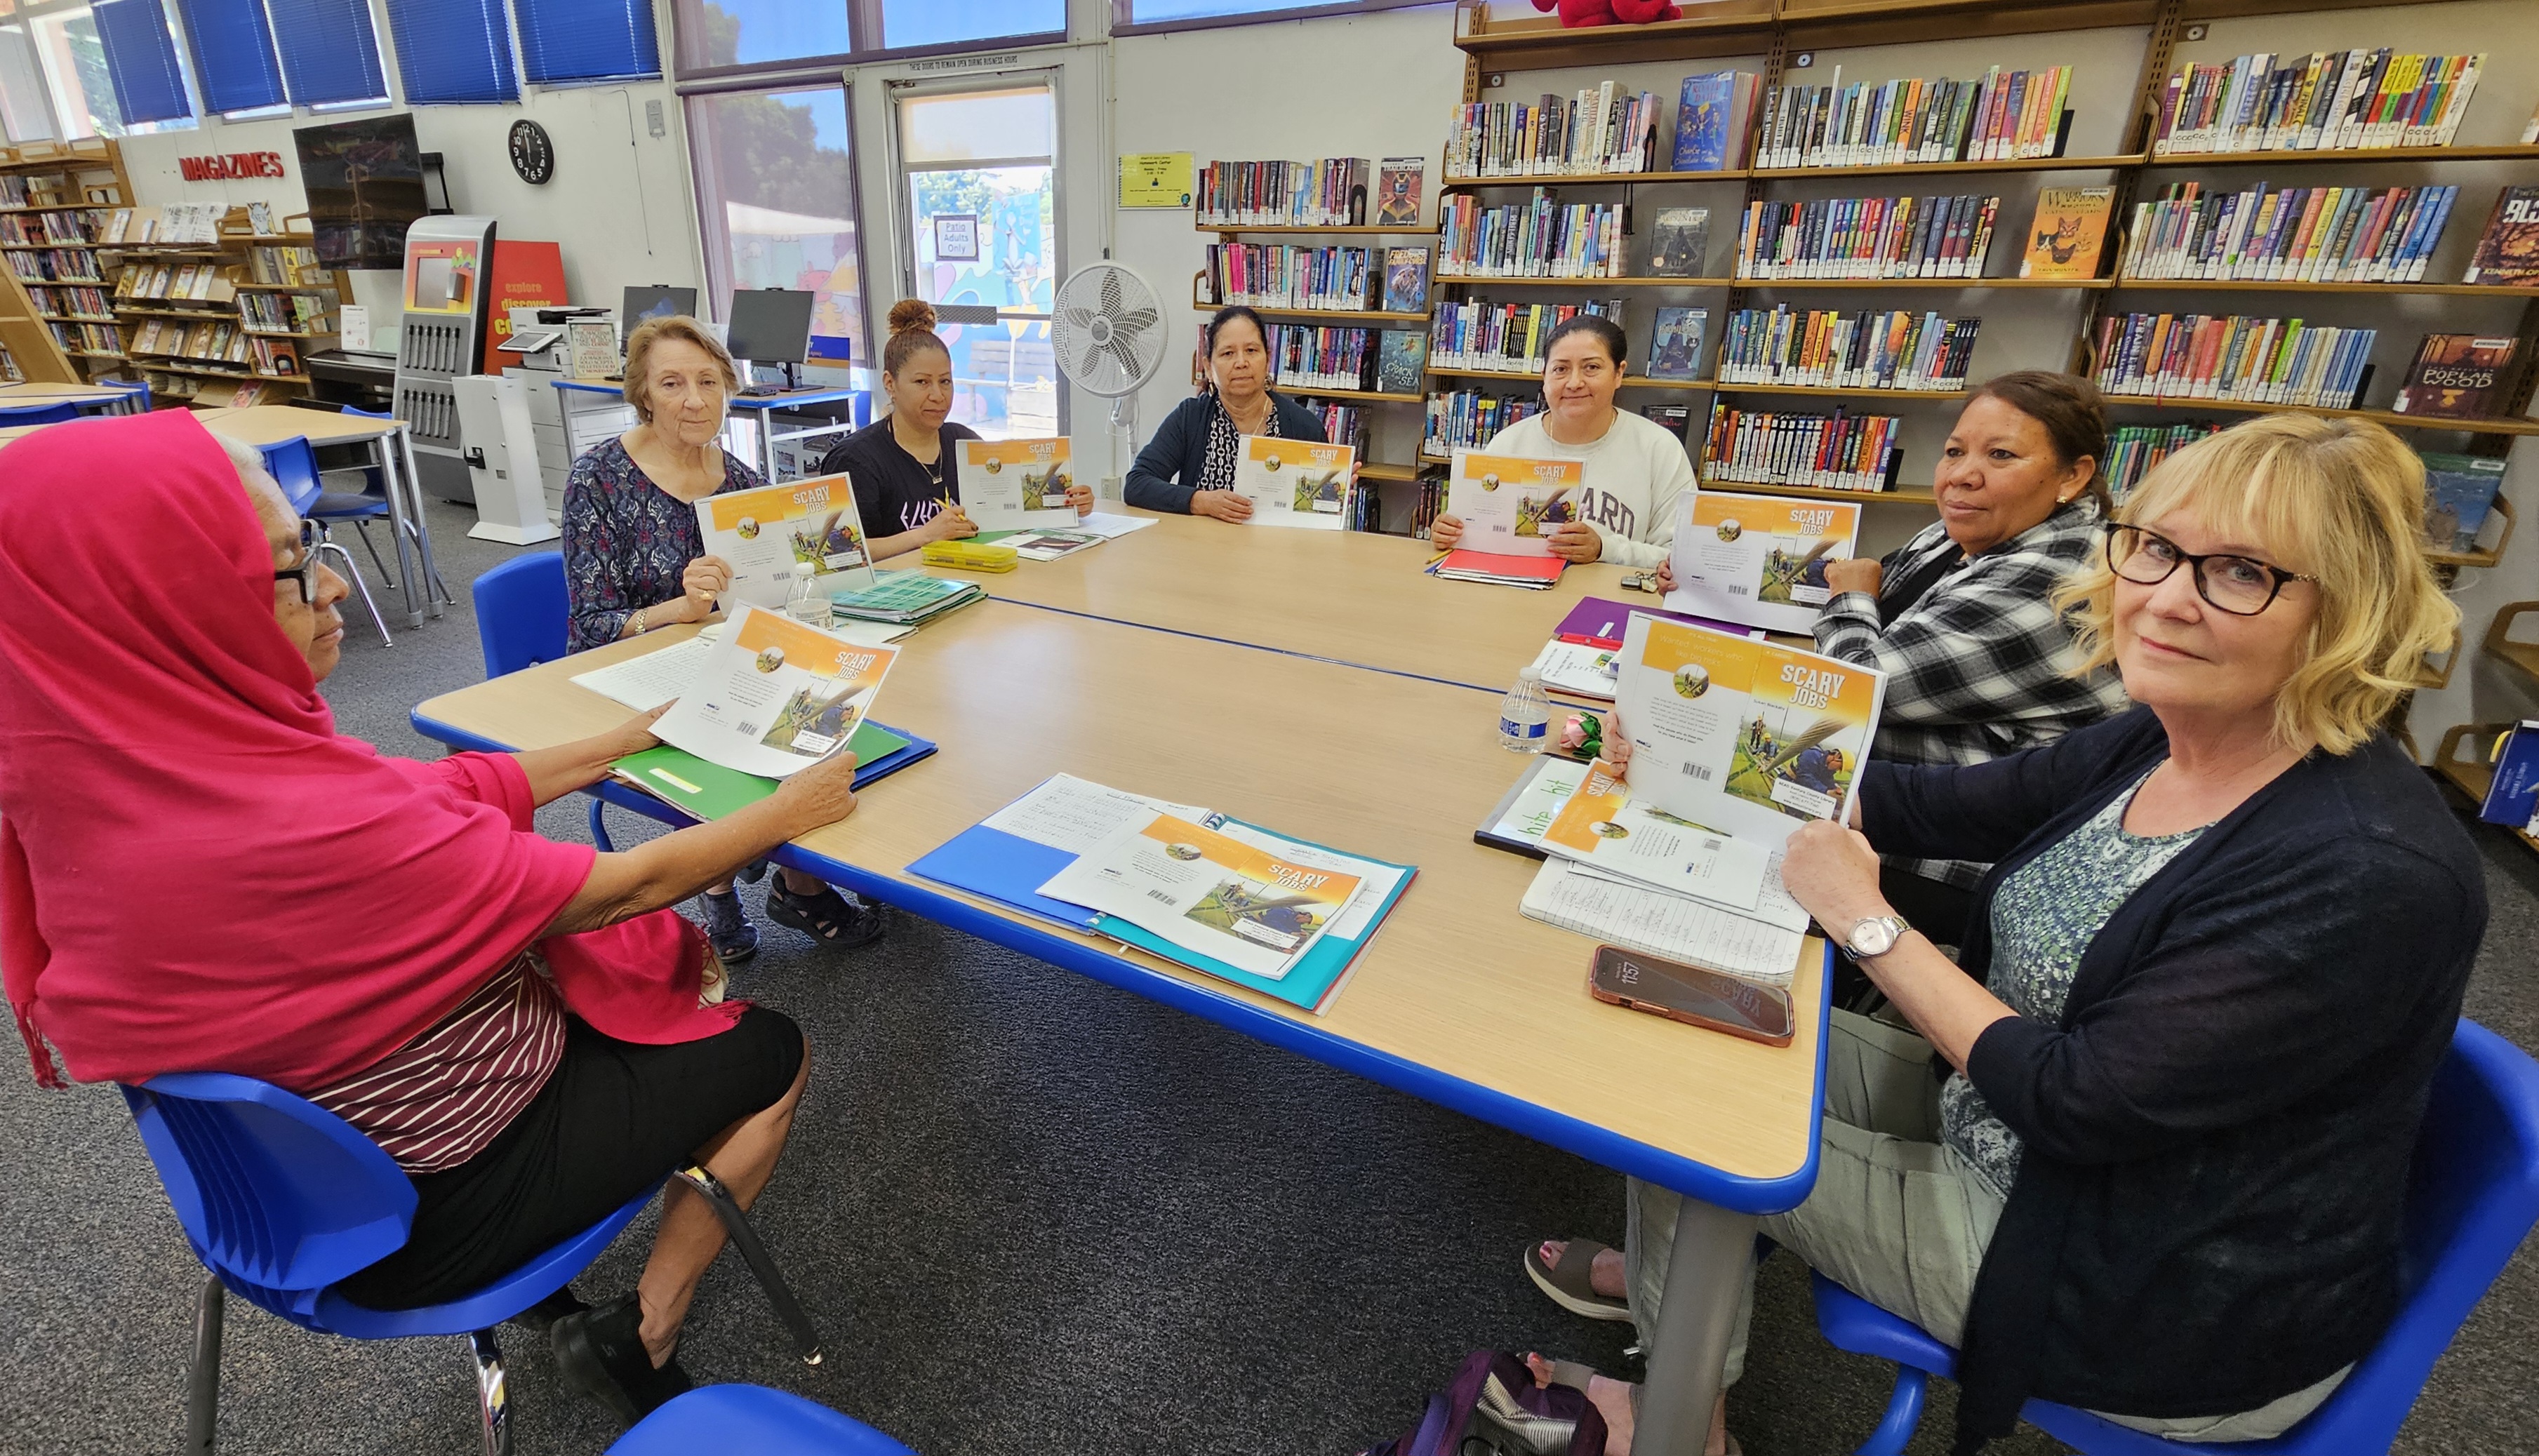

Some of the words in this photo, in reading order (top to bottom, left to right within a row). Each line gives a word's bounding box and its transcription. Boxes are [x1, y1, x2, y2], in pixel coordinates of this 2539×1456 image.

[968, 58, 982, 67] DURING
[983, 57, 1003, 65] BUSINESS
[2324, 81, 2335, 99] RAIN
[2333, 79, 2353, 118] GLITCH
[1588, 94, 1599, 127] MATILDA
[2295, 95, 2310, 119] FINAL
[1900, 109, 1914, 135] WINK
[513, 147, 519, 156] 9
[178, 152, 284, 181] MAGAZINES
[517, 158, 523, 168] 8
[540, 159, 545, 167] 4
[524, 168, 528, 176] 7
[531, 171, 536, 180] 6
[537, 168, 542, 177] 5
[2272, 202, 2287, 229] SHAKING
[946, 222, 966, 232] Patio
[2193, 213, 2207, 243] CLARICE
[2270, 231, 2279, 239] UP
[948, 245, 966, 254] Only
[505, 282, 542, 293] explore
[501, 298, 551, 312] discover
[1910, 328, 1920, 345] Omega
[2133, 321, 2147, 354] TRAIN
[1905, 346, 1916, 364] Morales
[1938, 349, 1947, 362] MARS
[1385, 362, 1413, 377] CRACK
[2115, 359, 2126, 384] LLAMAS
[2424, 369, 2493, 380] POPLAR
[1399, 376, 1420, 386] SEA
[2423, 379, 2493, 388] WOOD
[1028, 442, 1057, 455] SCARY
[1862, 432, 1873, 456] OPERATION
[1035, 453, 1052, 462] JOBS
[1310, 449, 1338, 461] SCARY
[1317, 458, 1331, 467] JOBS
[1533, 465, 1567, 478] SCARY
[1540, 476, 1559, 485] JOBS
[793, 485, 830, 504] SCARY
[806, 502, 827, 514] JOBS
[1582, 487, 1635, 541] ARD
[1790, 509, 1834, 526] SCARY
[1797, 523, 1823, 535] JOBS
[834, 650, 877, 672] SCARY
[1675, 648, 1688, 658] like
[1690, 653, 1702, 662] big
[1704, 656, 1721, 666] risks
[1693, 644, 1724, 657] workers
[1726, 652, 1743, 662] who
[834, 665, 860, 681] JOBS
[1780, 664, 1846, 699] SCARY
[1789, 686, 1828, 709] JOBS
[1587, 770, 1616, 797] SCARY
[1806, 789, 1820, 799] County
[1820, 795, 1834, 805] Library
[1267, 864, 1330, 890] SCARY
[1271, 876, 1310, 892] JOBS
[1622, 961, 1639, 984] 11:57
